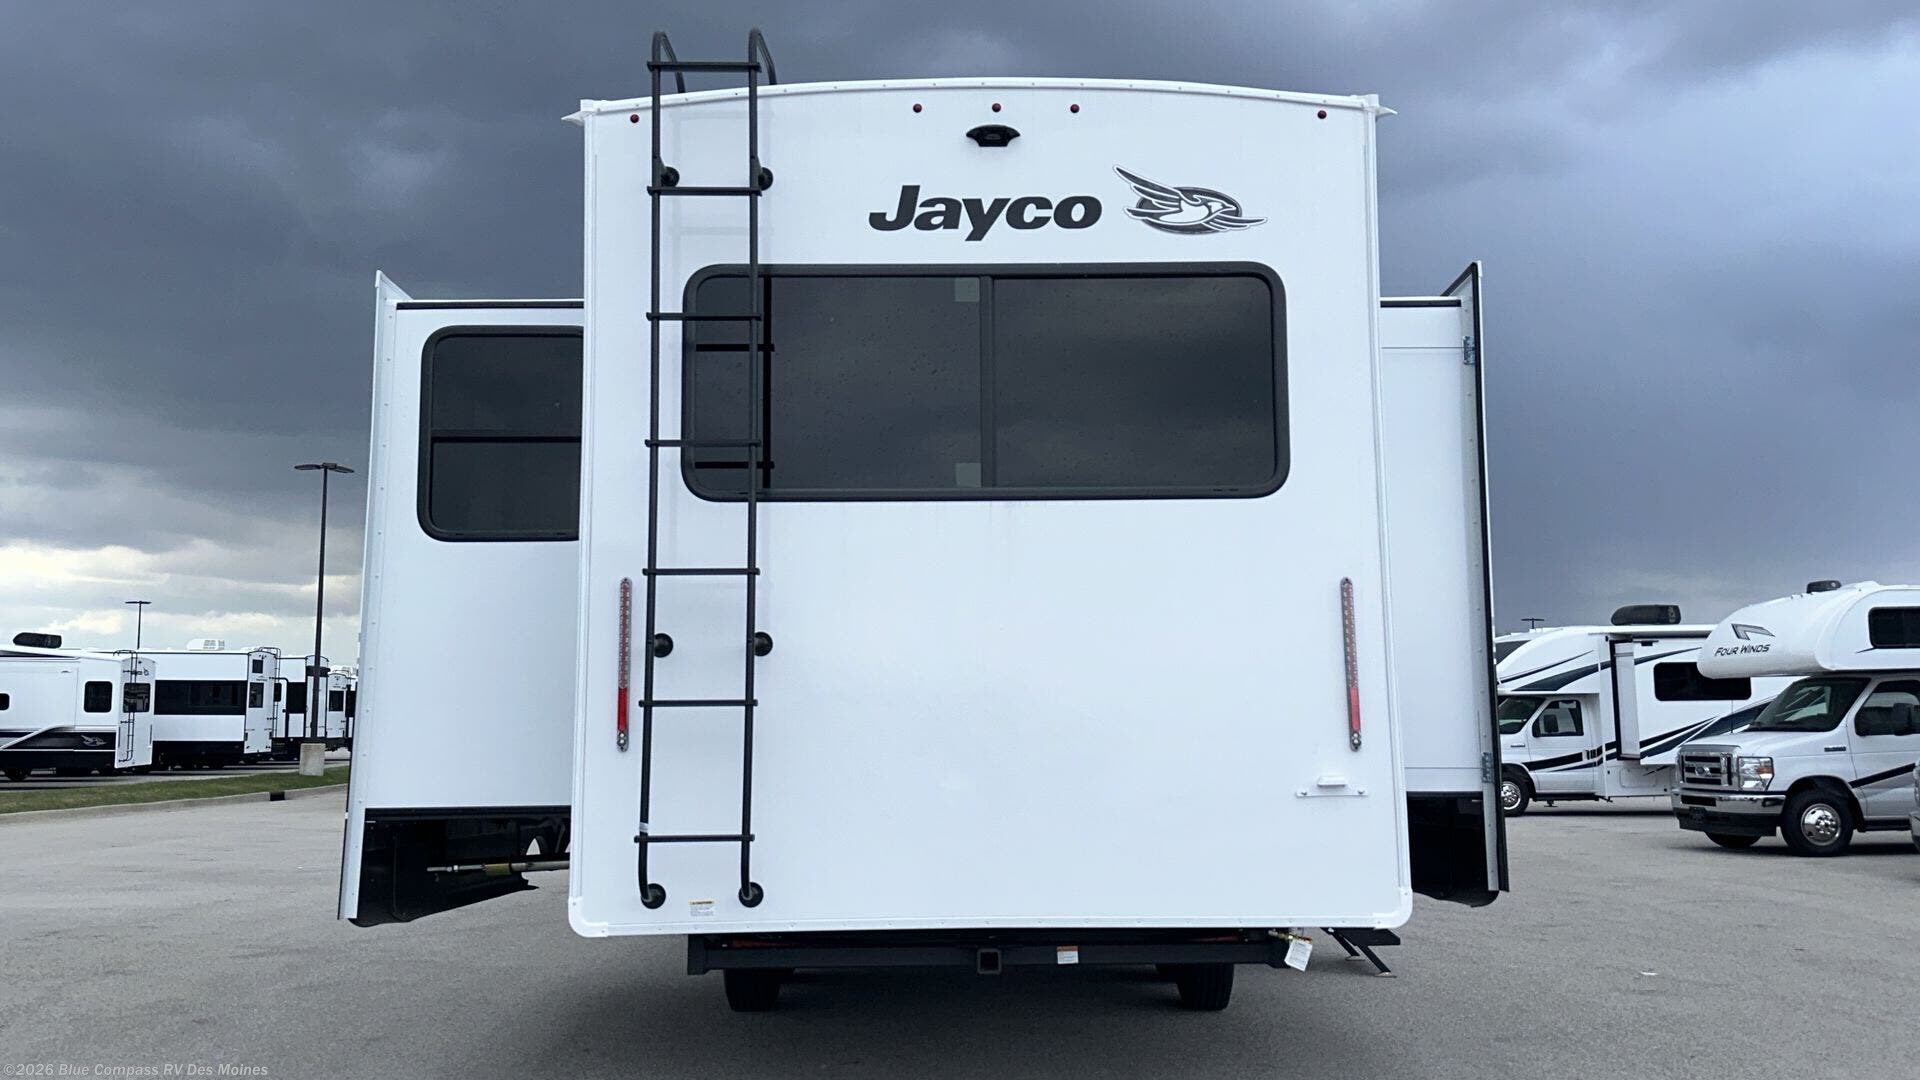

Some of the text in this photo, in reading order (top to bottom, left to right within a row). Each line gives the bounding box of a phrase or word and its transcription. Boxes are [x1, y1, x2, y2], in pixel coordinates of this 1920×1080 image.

[869, 185, 1102, 241] Jayco
[1714, 644, 1771, 657] FOUR WINDS
